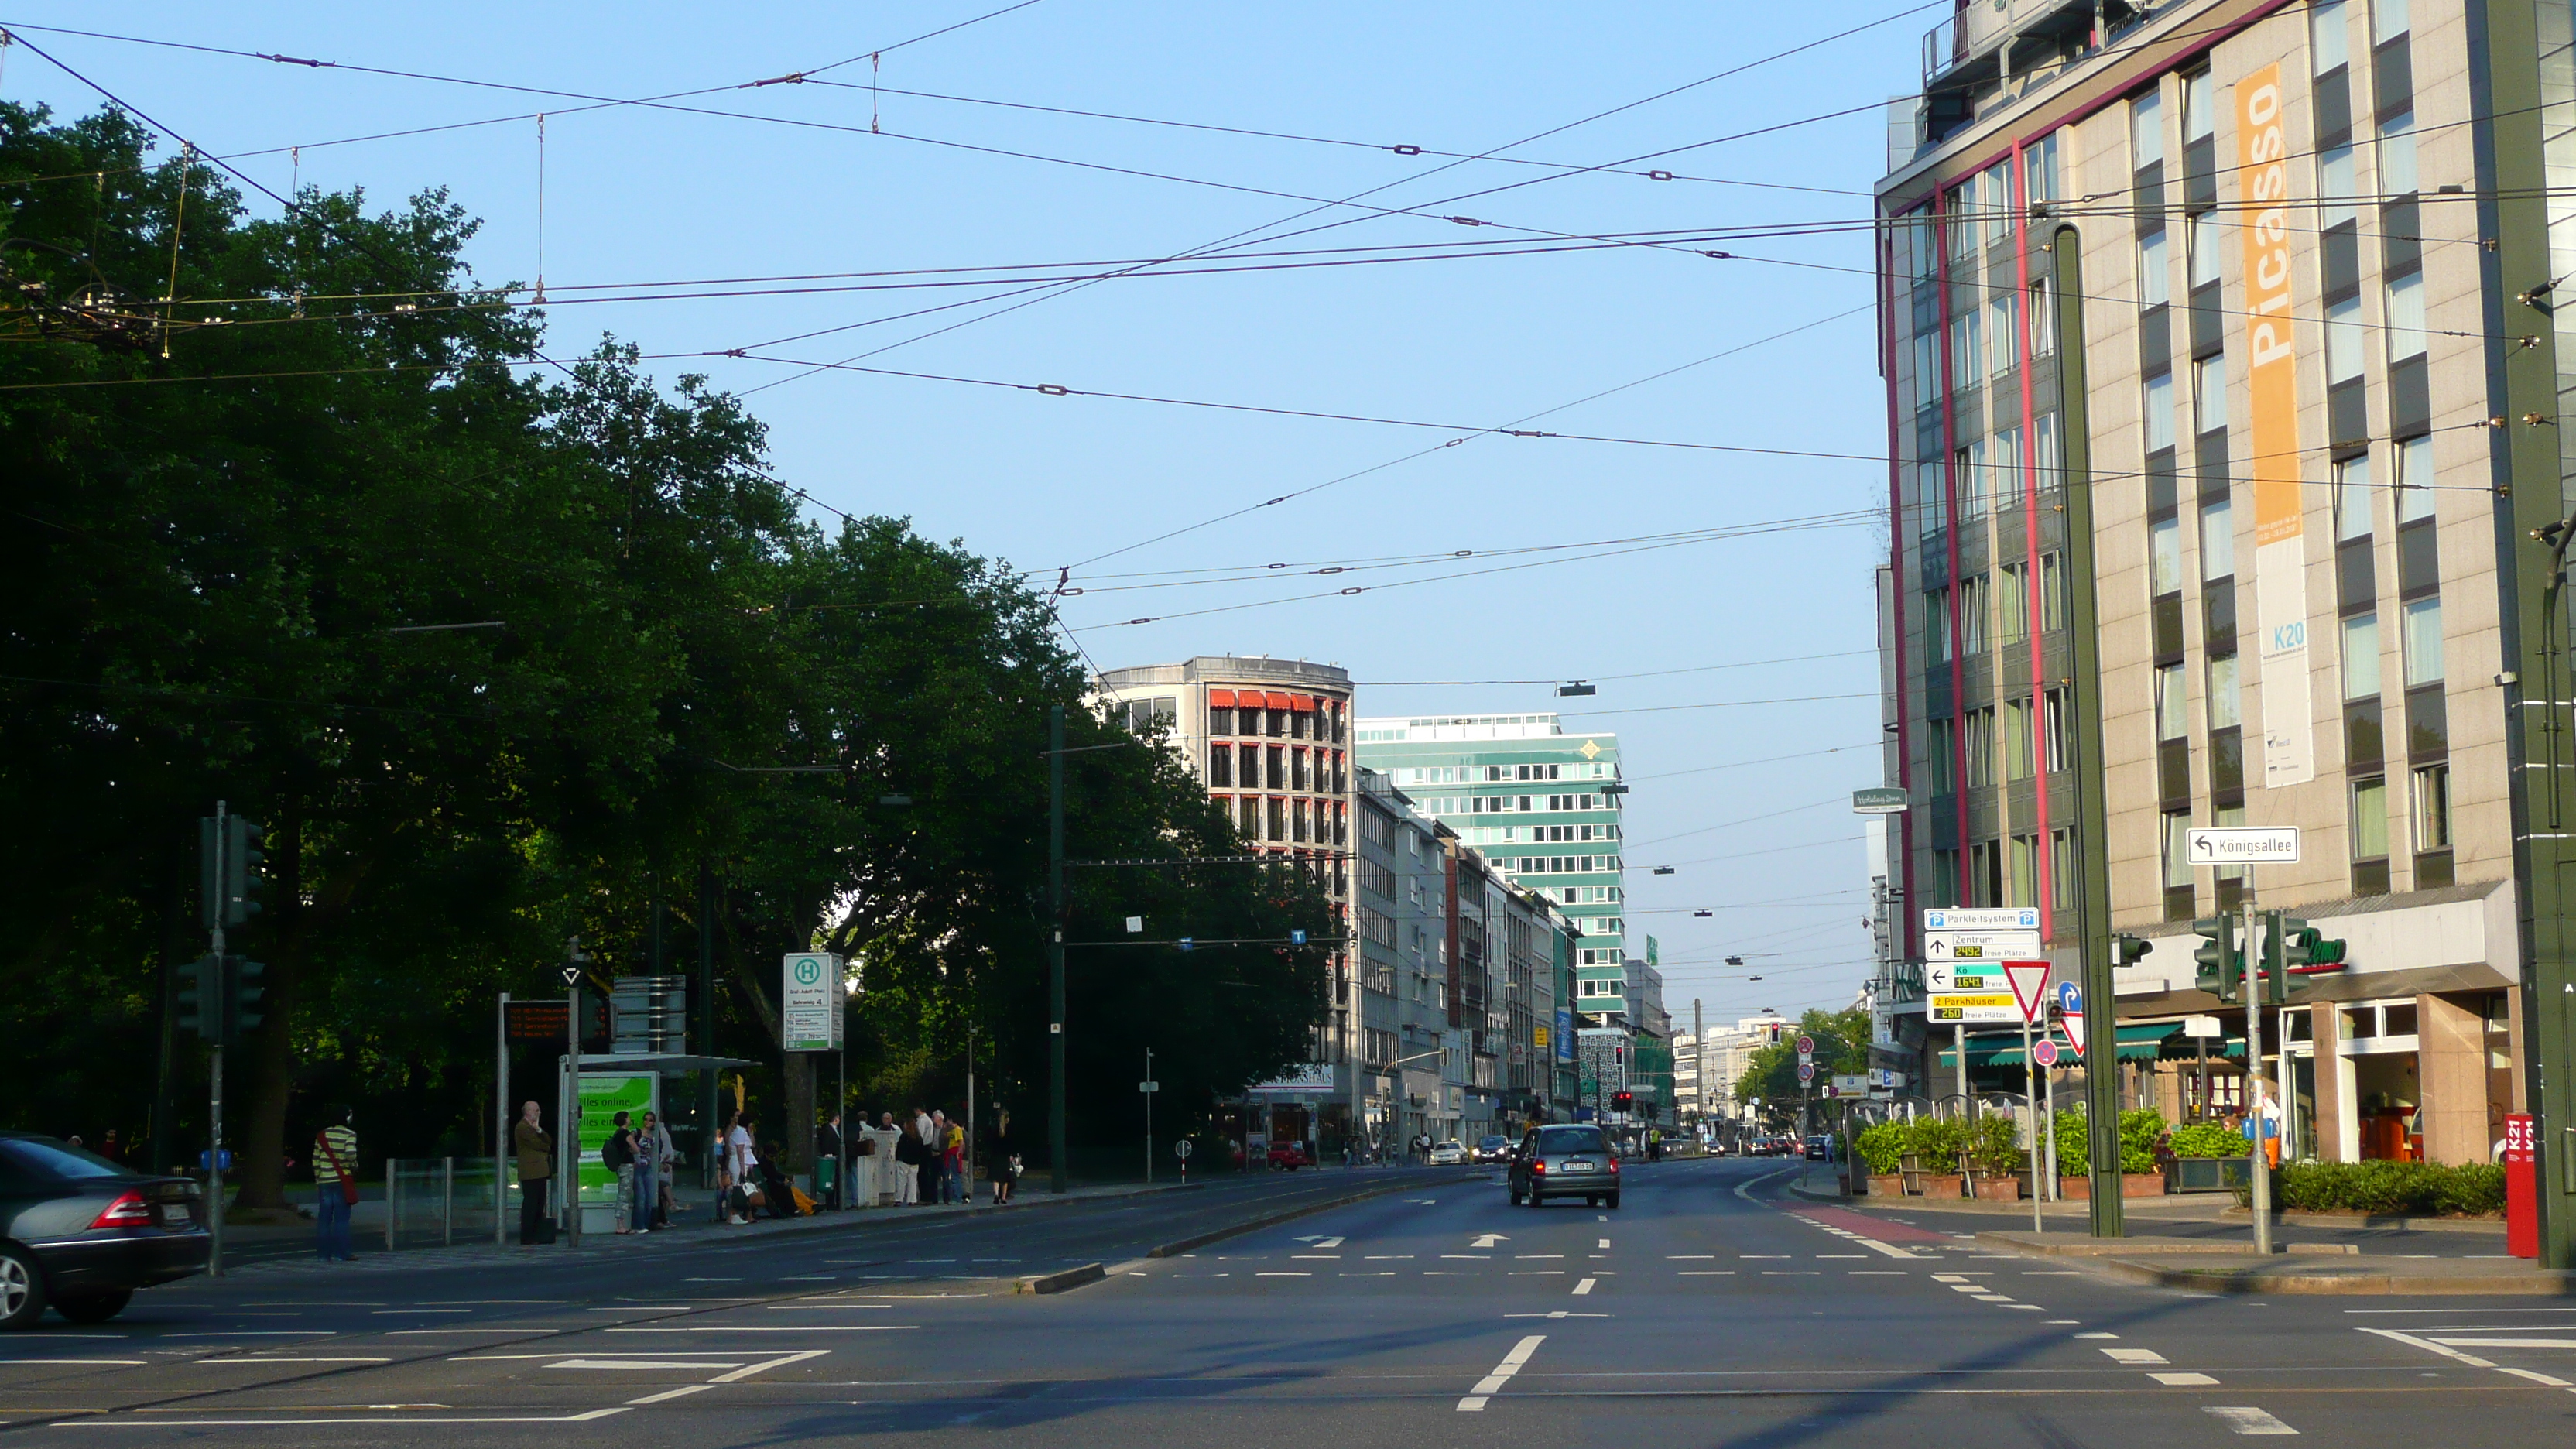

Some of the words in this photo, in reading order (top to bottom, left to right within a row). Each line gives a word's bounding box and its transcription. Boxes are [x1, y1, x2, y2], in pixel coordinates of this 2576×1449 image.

[2249, 84, 2290, 368] Picasso
[2274, 622, 2304, 650] K20
[1857, 795, 1885, 805] Holiday
[1886, 794, 1903, 803] Inn
[2219, 838, 2292, 855] Königsallee
[1947, 914, 2016, 924] Parkleitsystem
[1293, 931, 1303, 942] T
[1955, 936, 1994, 944] Zentrum
[1955, 947, 1982, 957] 2492
[1956, 966, 1968, 975] Kö
[1956, 977, 1982, 987] 1641
[2565, 983, 2574, 992] A
[1935, 998, 1941, 1006] 2
[1944, 997, 1996, 1006] Parkhäuser
[1941, 1009, 1961, 1019] 260
[601, 1097, 632, 1108] online,
[2508, 1120, 2521, 1150] K21
